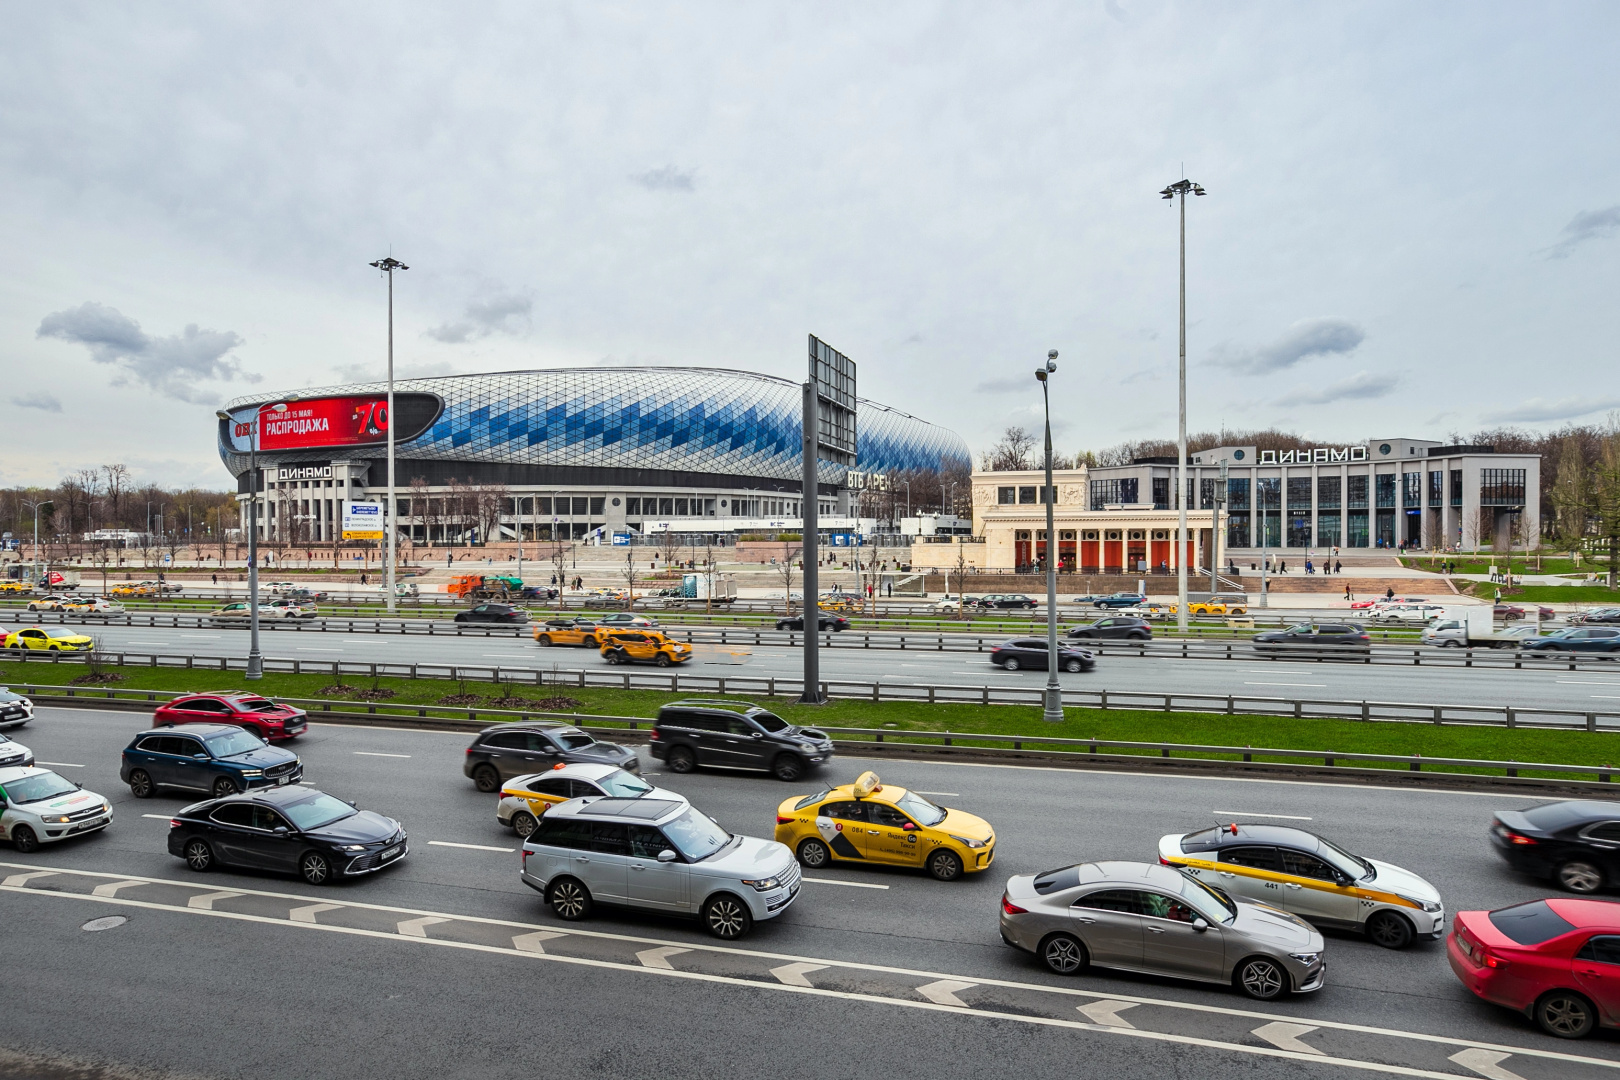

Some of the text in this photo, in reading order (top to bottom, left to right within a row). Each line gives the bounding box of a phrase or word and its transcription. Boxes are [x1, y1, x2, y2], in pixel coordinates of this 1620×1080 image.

[267, 412, 284, 421] ТОЛЬКО
[284, 411, 291, 420] ДО
[299, 409, 313, 417] МАЯ!
[355, 401, 389, 434] 70
[266, 418, 329, 436] РАСПРОДАЖА
[1260, 446, 1367, 465] ДИНАМО
[279, 467, 332, 480] ДИНАМО
[848, 471, 898, 492] ВТБ АРЕН
[887, 832, 907, 841] Яндекс
[900, 841, 916, 849] Такси
[1264, 882, 1278, 890] 441
